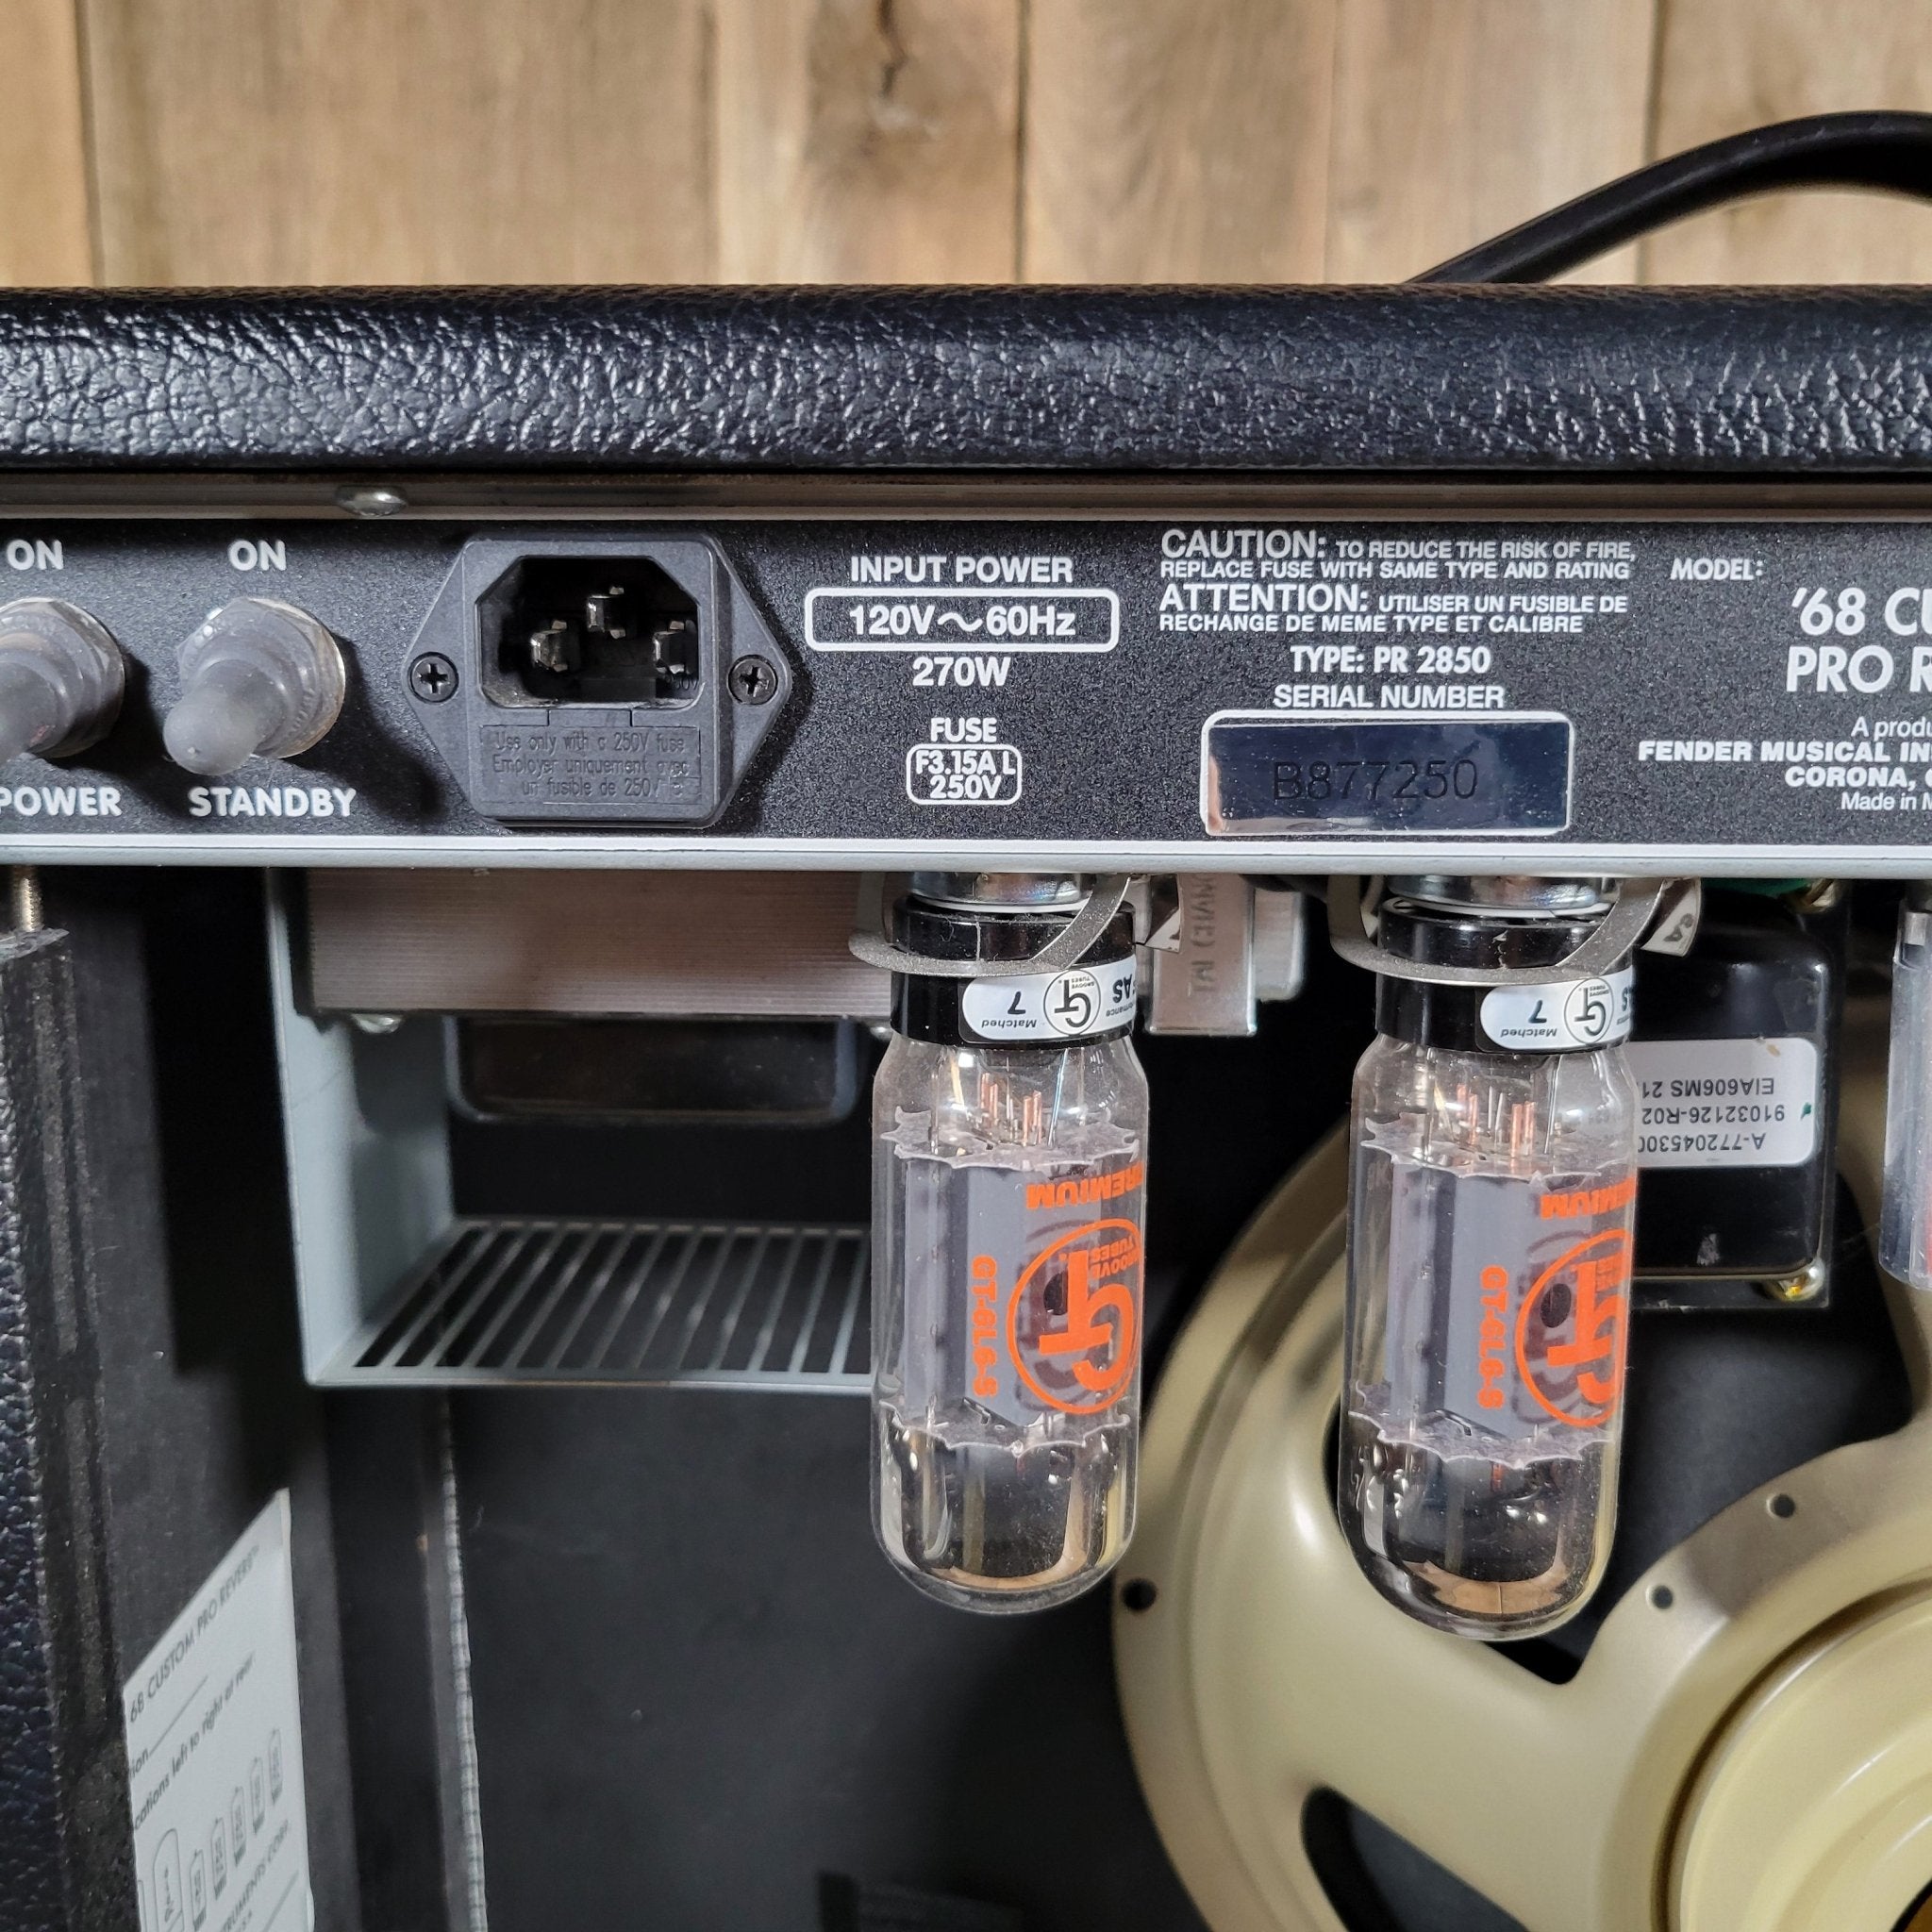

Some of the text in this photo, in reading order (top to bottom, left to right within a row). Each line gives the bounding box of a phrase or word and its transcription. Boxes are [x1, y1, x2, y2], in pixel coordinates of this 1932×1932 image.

[6, 539, 64, 571] ON
[227, 539, 287, 572] ON
[1161, 528, 1636, 562] CAUTION: TO REDUCE THE RISK OF FIRE,
[850, 556, 1074, 584] INPUT POWER
[1159, 560, 1630, 580] REPLACE FUSE WITH SAME TYPE AND RATING
[1669, 558, 1764, 581] MODEL:
[1158, 583, 1628, 614] ATTENTION: UTILISER UN FUSIBLE DE
[1159, 614, 1583, 634] RECHANGE DE MEME TYPE ET CALIBRE
[912, 656, 1011, 687] 270W
[1290, 645, 1492, 674] TYPE: PR 2850
[1786, 644, 1895, 694] PRO
[1273, 684, 1506, 710] SERIAL NUMBER
[930, 717, 997, 743] FUSE
[1851, 715, 1870, 738] A
[527, 733, 558, 756] only
[562, 732, 591, 753] with
[613, 732, 651, 754] 250V
[657, 733, 687, 755] fuse
[1638, 740, 1753, 762] FENDER
[1759, 741, 1891, 763] MUSICAL
[492, 754, 560, 779] Employer
[565, 757, 648, 777] uniquement
[915, 750, 1016, 775] F3.15A L
[546, 778, 593, 799] fusible
[599, 778, 618, 799] de
[929, 774, 1003, 800] 250V
[1273, 758, 1479, 801] B877250
[1784, 765, 1917, 791] CORONA,
[188, 786, 358, 818] STANDBY
[1840, 791, 1895, 811] Made
[1898, 791, 1918, 811] in
[1008, 991, 1026, 1015] 7
[1528, 999, 1547, 1024] 7
[981, 1019, 1038, 1029] Matched
[1500, 1027, 1558, 1039] Matched
[1670, 1077, 1775, 1098] EIA606MS
[1641, 1104, 1786, 1125] 91032126-R02
[147, 1629, 195, 1699] CUSTOM
[134, 1774, 171, 1830] cations
